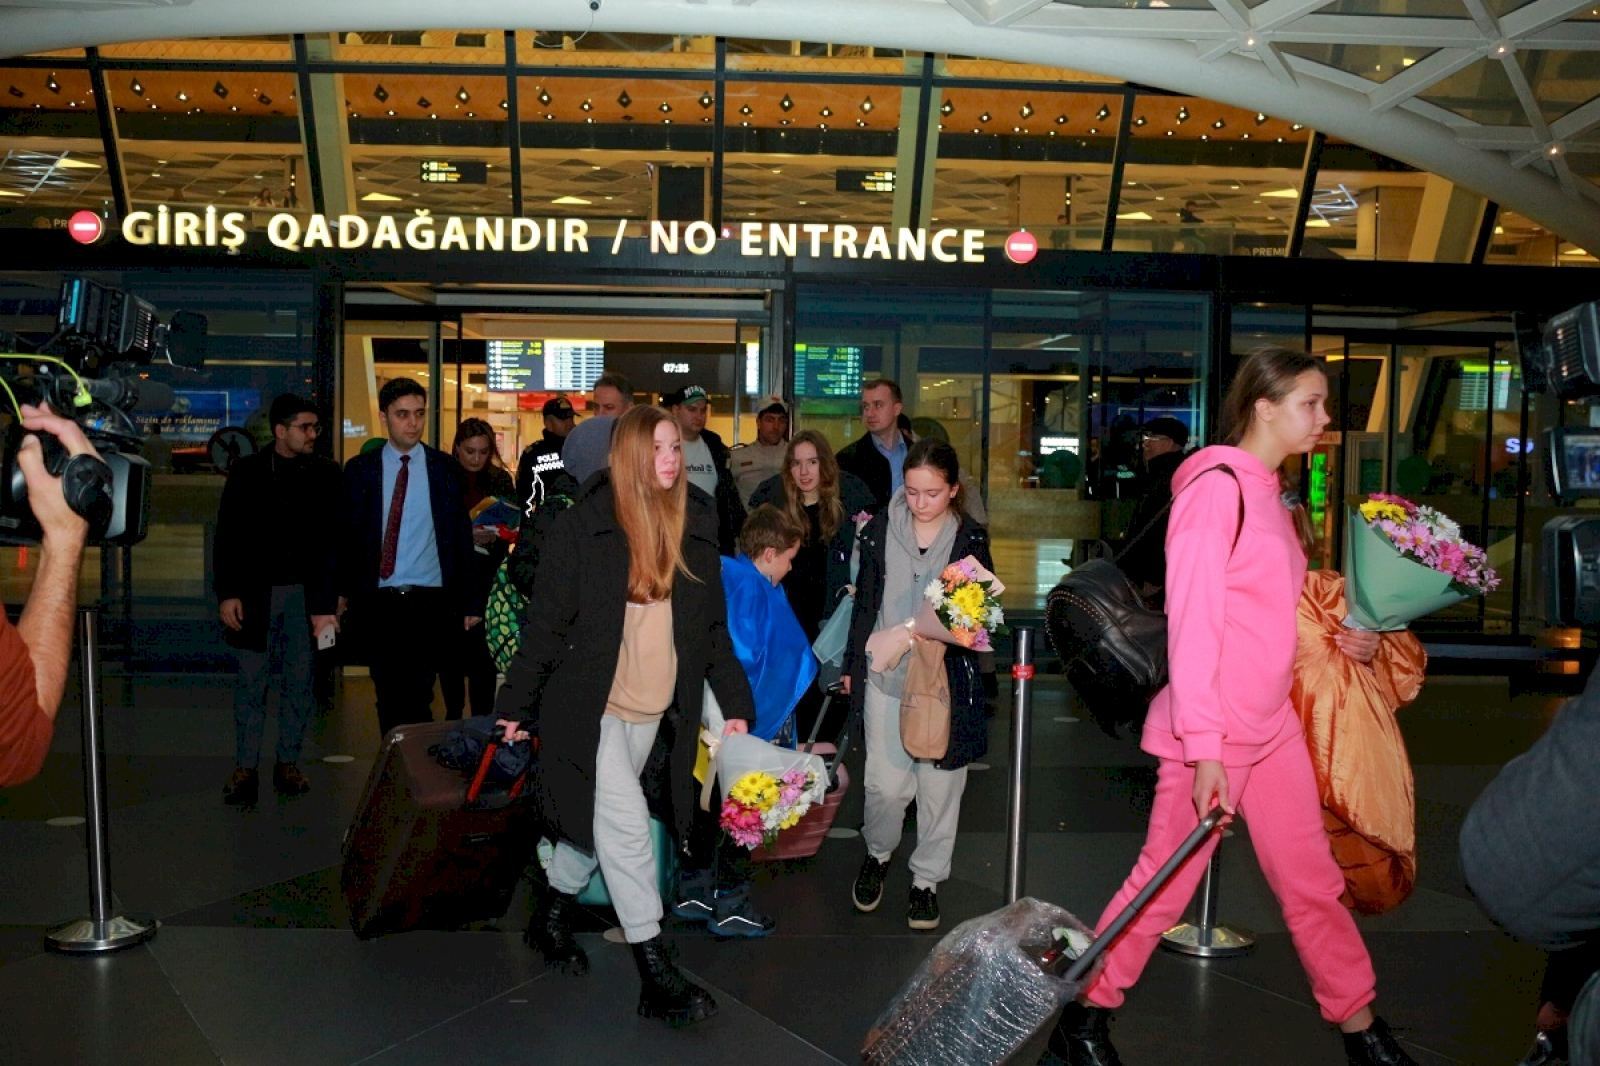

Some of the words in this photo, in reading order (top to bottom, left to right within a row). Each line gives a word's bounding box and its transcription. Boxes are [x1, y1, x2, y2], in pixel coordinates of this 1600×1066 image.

[122, 204, 246, 255] GİRİŞ
[267, 208, 589, 252] QADAĞANDIR
[611, 219, 628, 254] /
[650, 220, 717, 254] NO
[740, 222, 985, 263] ENTRANCE
